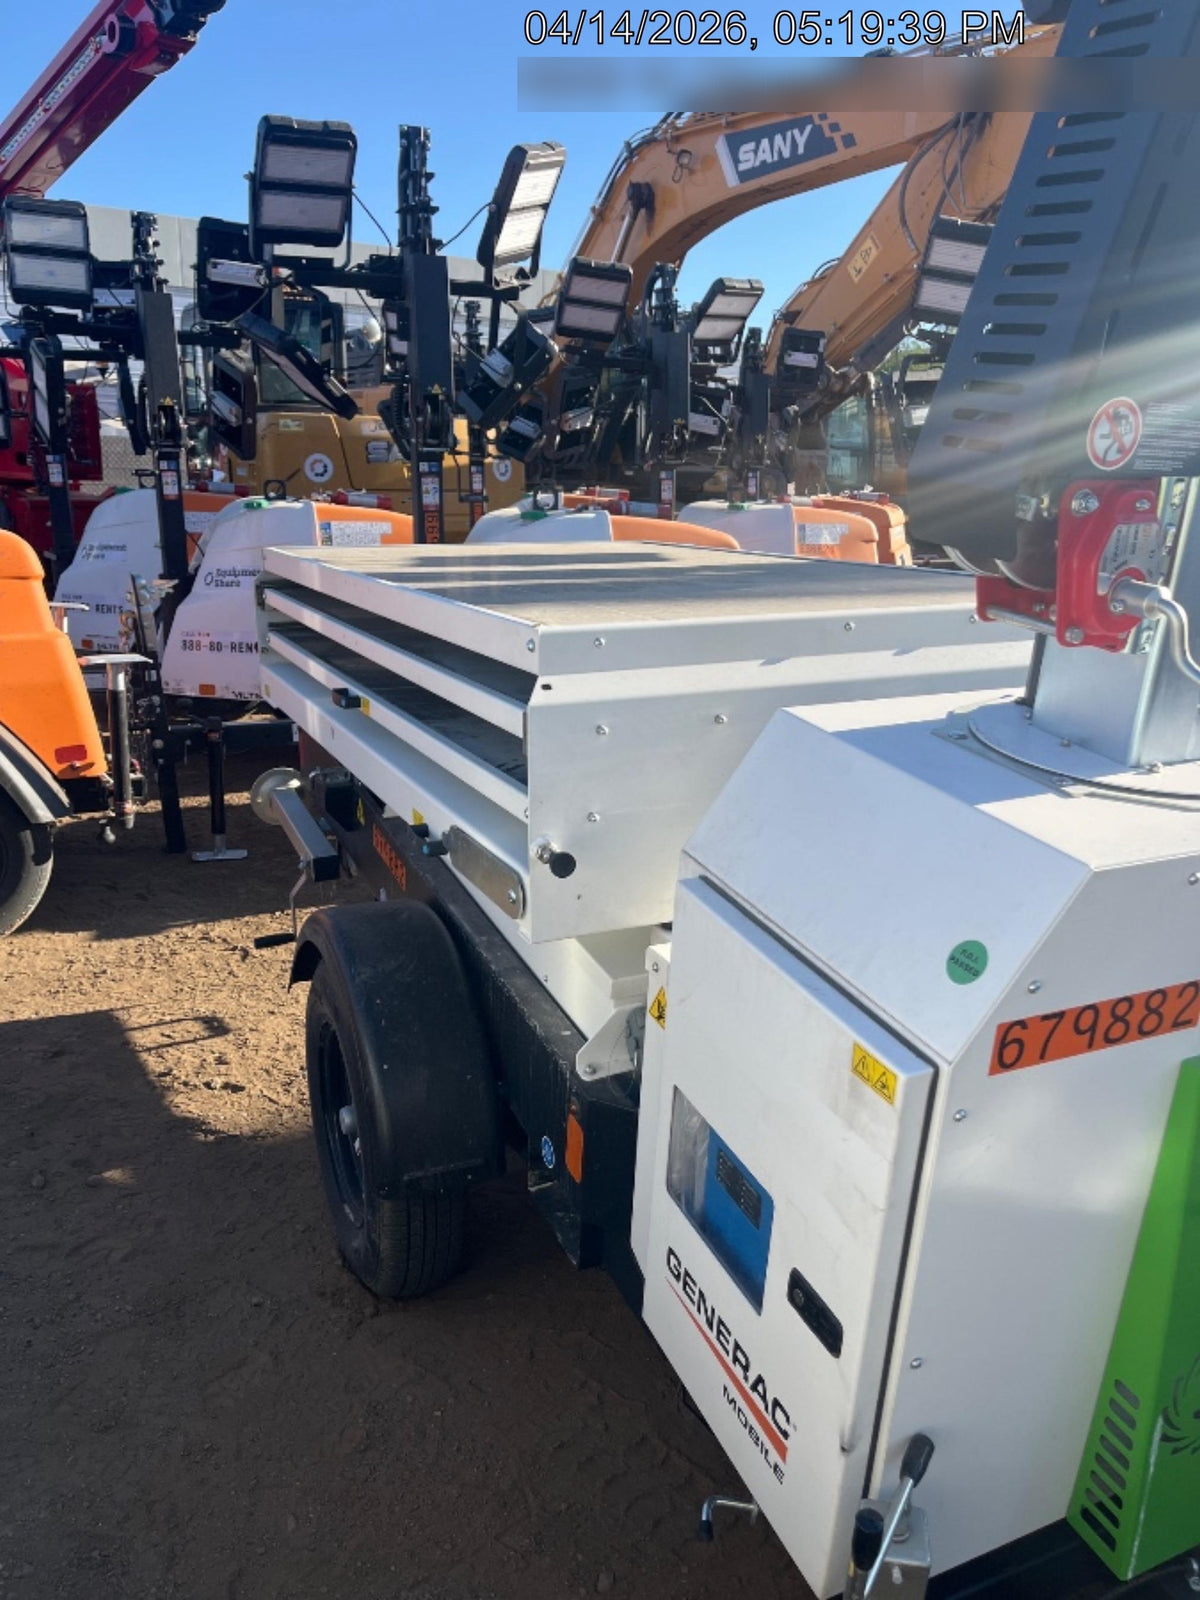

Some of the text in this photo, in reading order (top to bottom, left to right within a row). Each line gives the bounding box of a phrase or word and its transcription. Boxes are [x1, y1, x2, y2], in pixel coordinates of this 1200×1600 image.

[737, 123, 814, 172] SANY
[996, 980, 1200, 1070] 679882
[666, 1245, 791, 1441] GENERAC
[722, 1383, 785, 1485] MOBILE
